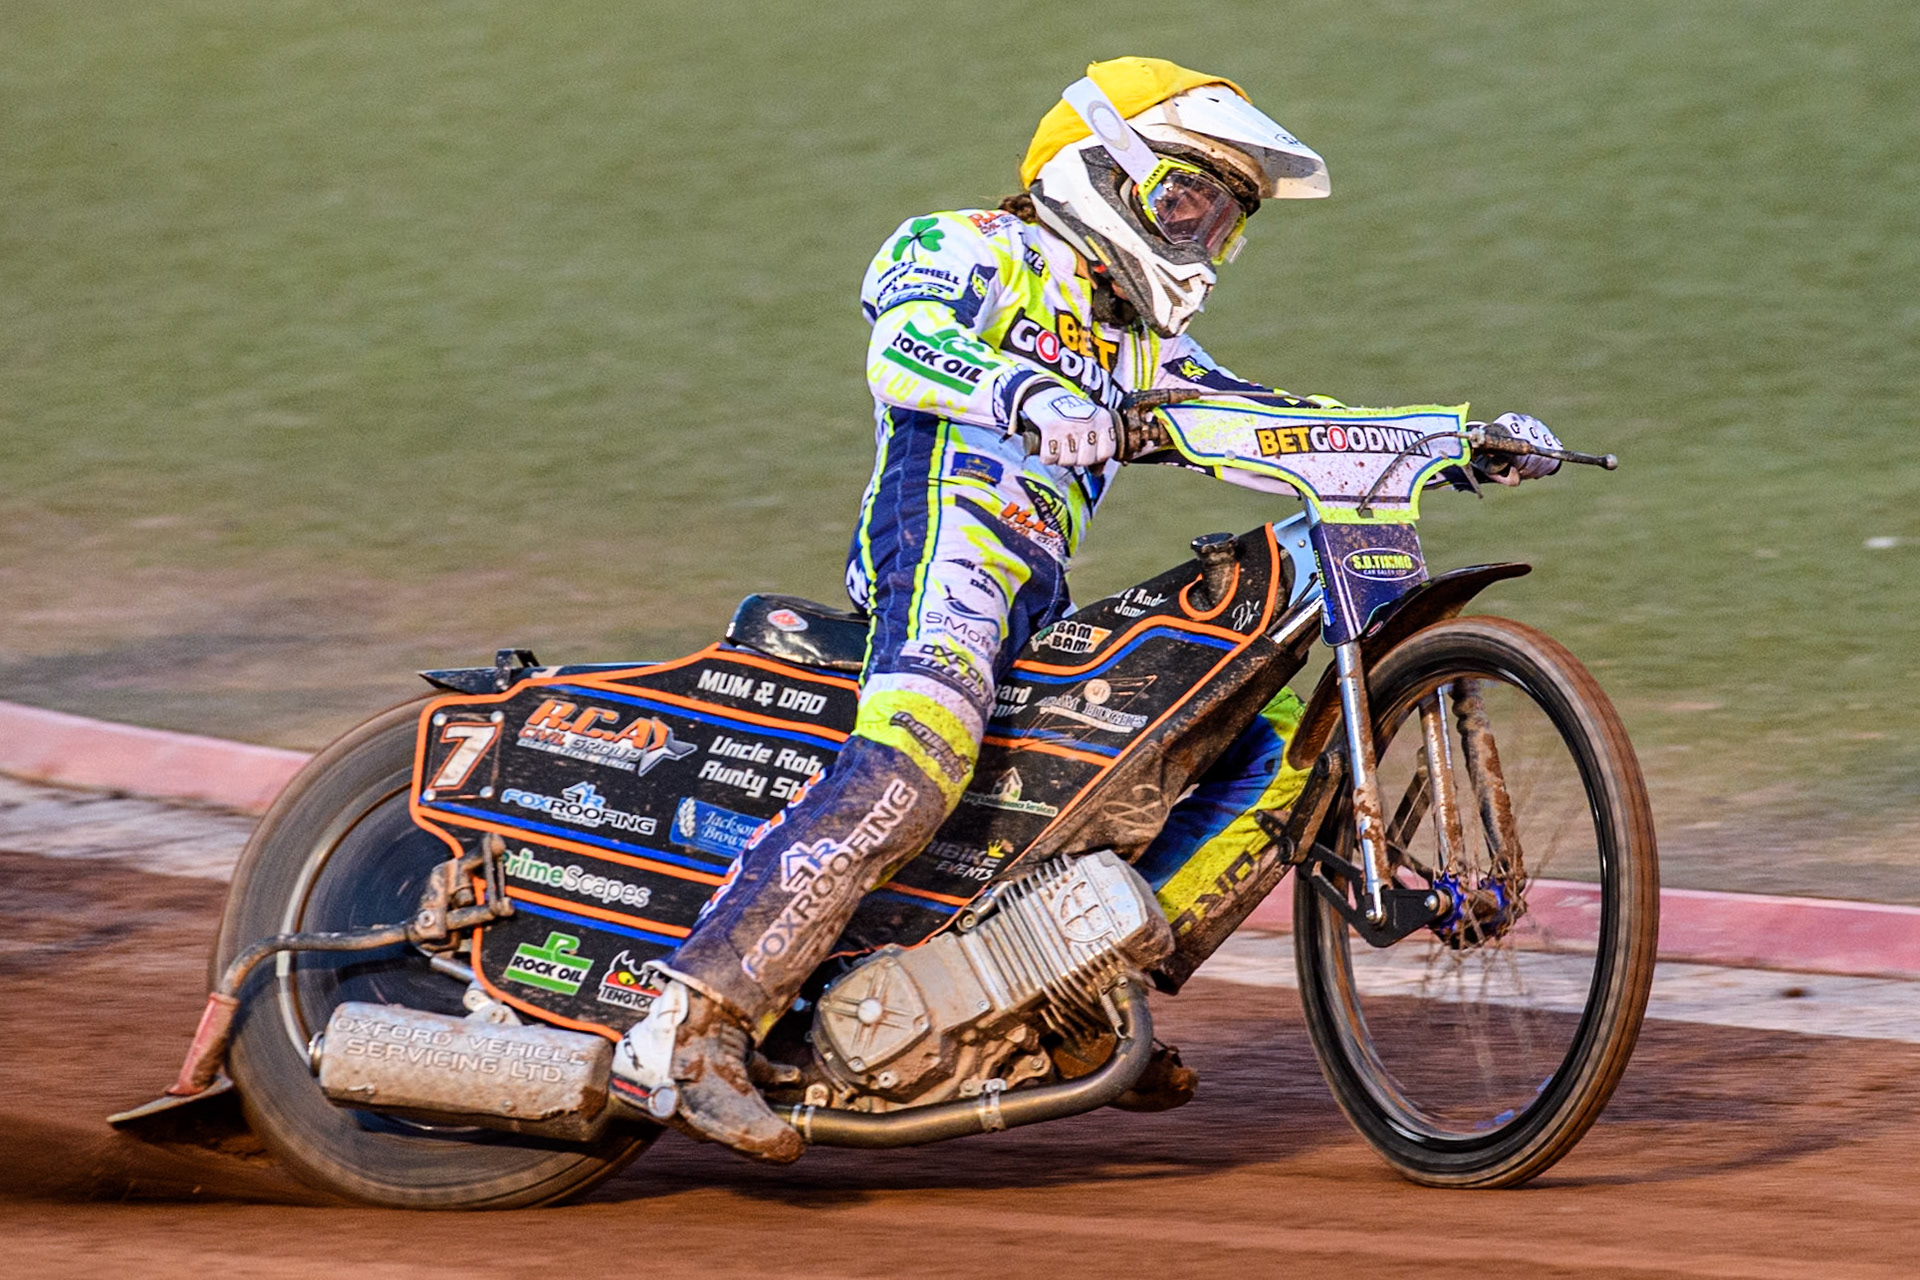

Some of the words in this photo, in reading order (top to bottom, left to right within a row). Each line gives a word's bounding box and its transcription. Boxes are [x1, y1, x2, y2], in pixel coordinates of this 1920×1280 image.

[1058, 313, 1117, 372] BET
[943, 359, 982, 384] OIL
[1257, 425, 1431, 457] BETGOODWIN
[1056, 622, 1092, 640] BAM
[697, 669, 754, 699] MUM
[753, 681, 776, 706] &
[777, 687, 827, 715] DAD
[427, 721, 502, 791] 7
[570, 738, 642, 763] GROUP
[708, 735, 774, 763] Uncle
[774, 748, 823, 776] Rob
[698, 760, 768, 798] Aunty
[501, 788, 657, 836] FOXROOFING
[741, 778, 919, 982] FOXROOFING
[935, 860, 994, 881] EVENTS
[511, 955, 556, 977] ROCK
[558, 966, 583, 984] OIL
[334, 1018, 452, 1047] OXFORD
[468, 1034, 588, 1066] VEHICLE
[346, 1038, 498, 1074] SERVICING
